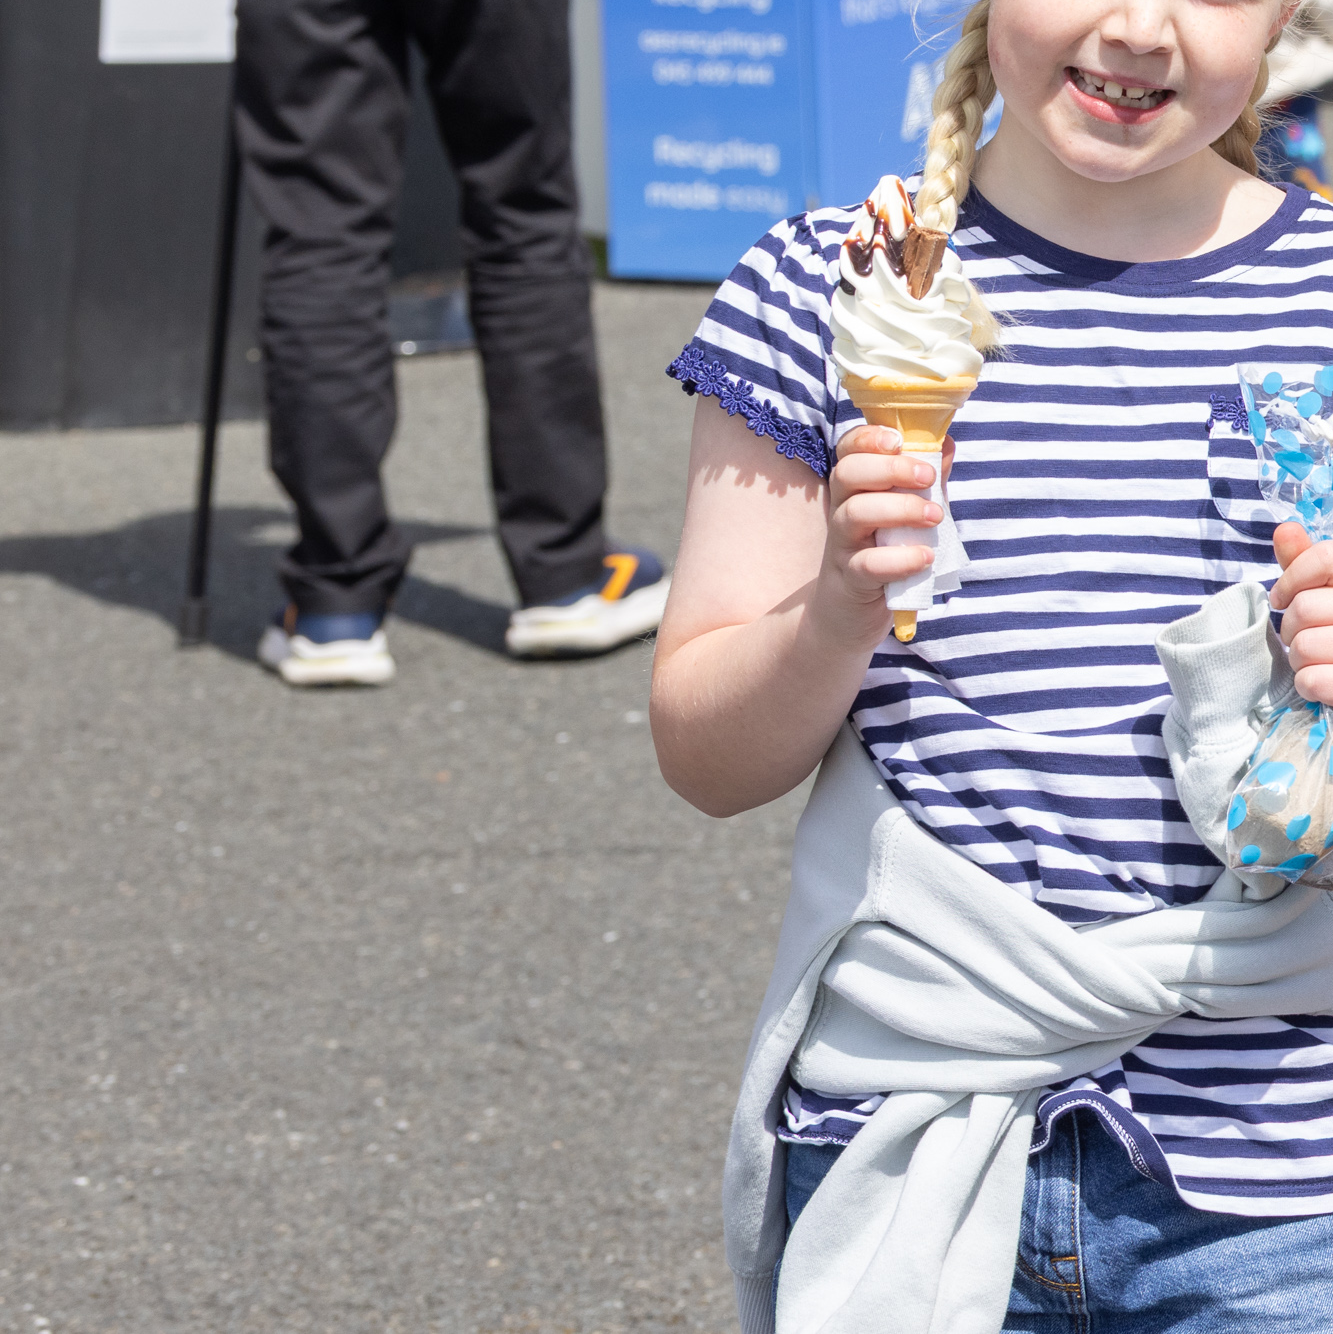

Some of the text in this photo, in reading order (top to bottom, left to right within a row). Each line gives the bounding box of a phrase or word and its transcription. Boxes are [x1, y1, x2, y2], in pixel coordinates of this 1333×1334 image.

[653, 135, 781, 177] Recycling
[645, 182, 788, 217] made easy
